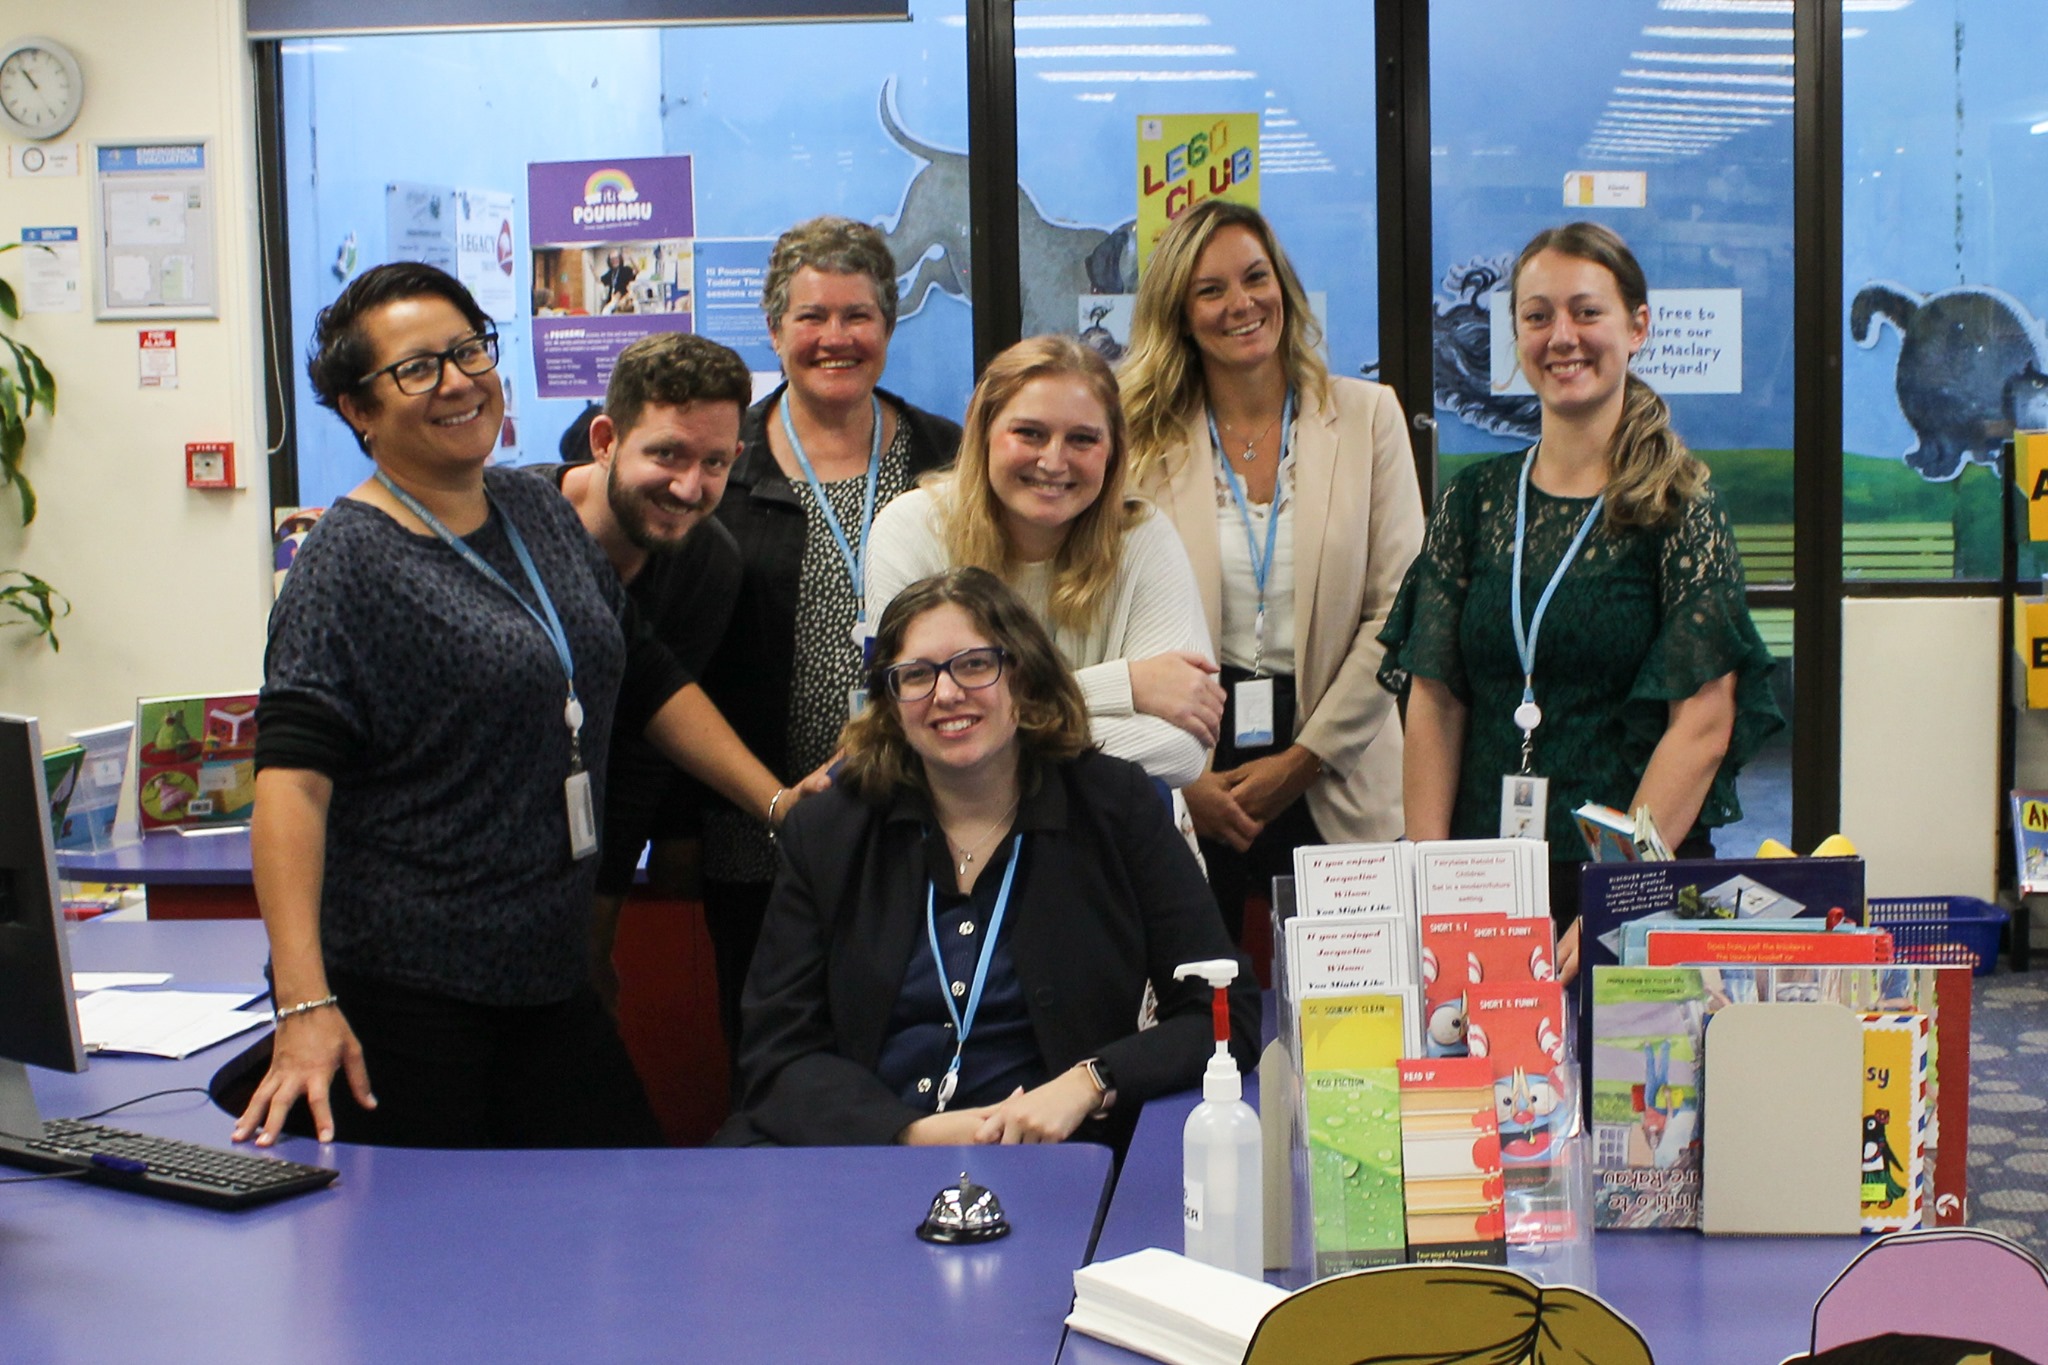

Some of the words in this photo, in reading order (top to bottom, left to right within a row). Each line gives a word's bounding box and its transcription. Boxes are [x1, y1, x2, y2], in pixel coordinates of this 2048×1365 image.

[1144, 120, 1229, 196] LEGO
[1166, 147, 1252, 220] CLUB
[573, 201, 652, 225] POUNAMU
[717, 267, 760, 276] Pounamu
[706, 278, 741, 287] Toddler
[1659, 306, 1692, 321] free
[1699, 307, 1715, 321] to
[1688, 328, 1712, 338] our
[1662, 342, 1721, 362] Maclary
[1636, 361, 1708, 380] ourtyard!
[1346, 856, 1385, 866] enjoyed
[1324, 873, 1377, 884] Jacqueline
[1339, 905, 1367, 915] Might
[1370, 904, 1391, 912] Like
[1430, 922, 1453, 933] SHORT
[1474, 927, 1497, 938] SHORT
[1508, 926, 1531, 937] FUNNY
[1341, 929, 1381, 940] enjoyed
[1317, 947, 1372, 957] Jacqueline
[1331, 980, 1360, 988] Might
[1363, 979, 1385, 987] Like
[1480, 999, 1504, 1010] SHORT
[1514, 997, 1539, 1008] FUNNY
[1361, 1005, 1385, 1014] CLEAN
[1403, 1071, 1423, 1082] READ
[1334, 1078, 1364, 1087] FICTION
[1608, 1194, 1629, 1213] te
